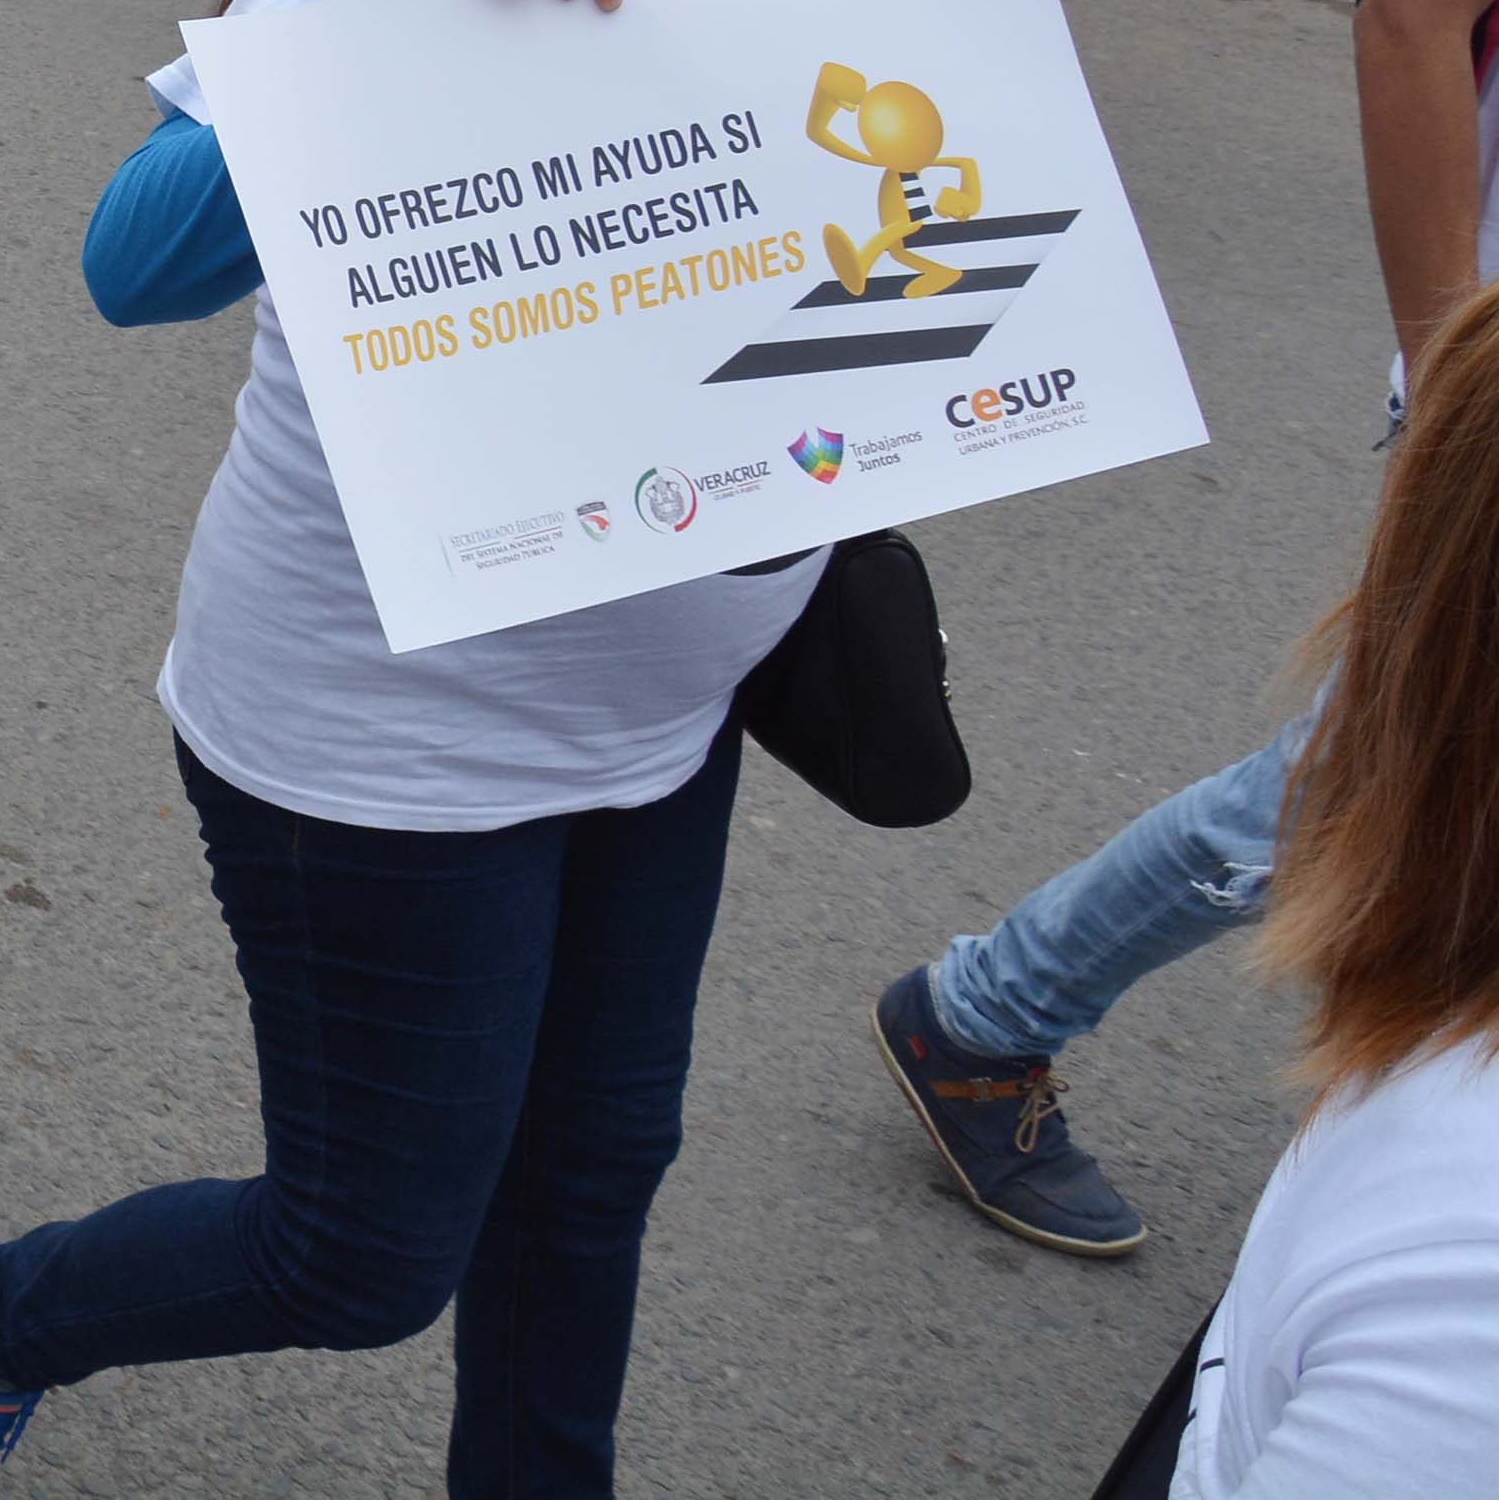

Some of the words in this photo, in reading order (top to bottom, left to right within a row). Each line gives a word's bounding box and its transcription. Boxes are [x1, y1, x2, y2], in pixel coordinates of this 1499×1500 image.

[300, 203, 348, 248] YO
[355, 167, 523, 240] OFREZCO
[531, 153, 583, 200] MI
[594, 122, 717, 187] AYUDA
[722, 110, 762, 155] SI
[347, 237, 503, 309] ALGUIEN
[510, 225, 561, 272] LO
[570, 177, 760, 258] NECESITA
[343, 314, 459, 375] TODOS
[469, 280, 599, 350] SOMOS
[610, 230, 805, 316] PEATONES
[945, 368, 1075, 428] CeSUP
[954, 424, 997, 442] CENTRO
[1004, 419, 1018, 429] DE
[1025, 401, 1084, 425] SEGURIDAD
[849, 430, 923, 458] Trabajamos
[858, 452, 901, 472] Juntos
[694, 461, 771, 493] VERACRUZ
